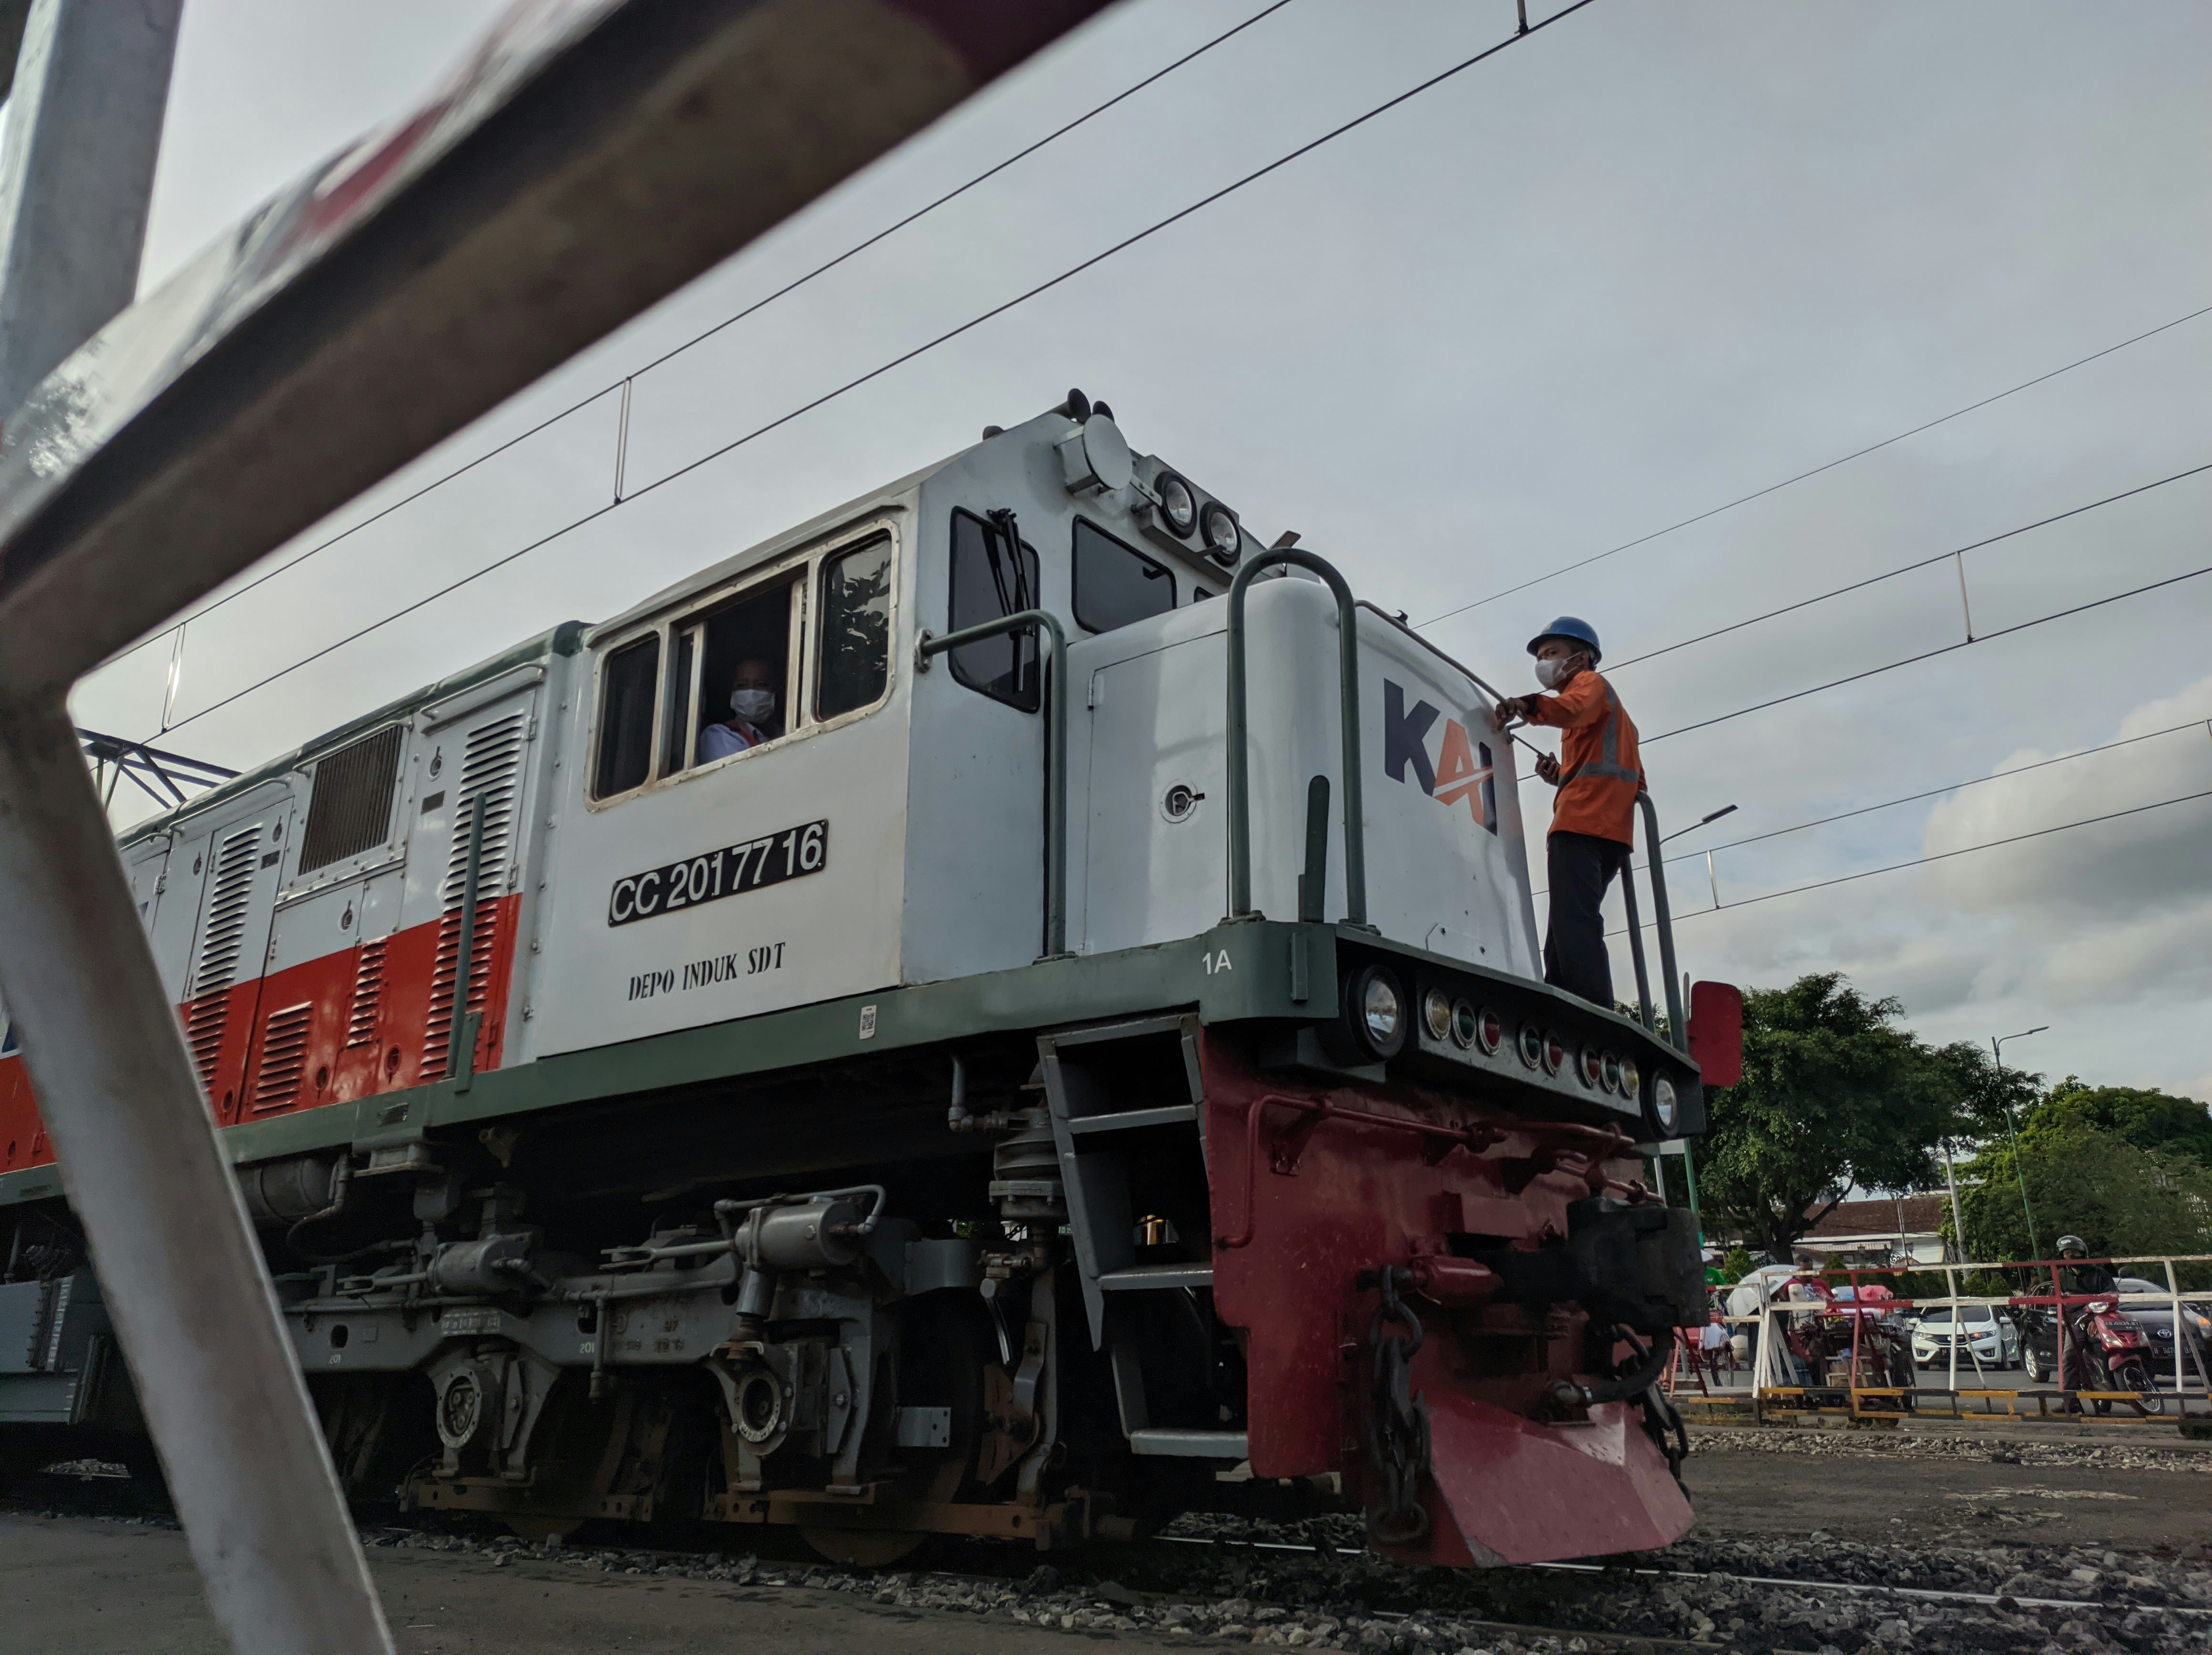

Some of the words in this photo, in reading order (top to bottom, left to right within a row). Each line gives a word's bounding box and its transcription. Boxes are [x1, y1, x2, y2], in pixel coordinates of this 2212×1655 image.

[1383, 677, 1497, 837] KAI
[611, 872, 661, 922] CC
[666, 851, 724, 909] 201
[731, 838, 774, 890] 77
[782, 823, 824, 876] 16
[628, 969, 675, 1001] DEPO
[682, 953, 738, 991] INDUK
[747, 942, 786, 975] SDT
[1202, 950, 1232, 975] 1A
[329, 1354, 341, 1364] 201
[580, 1342, 595, 1353] 201
